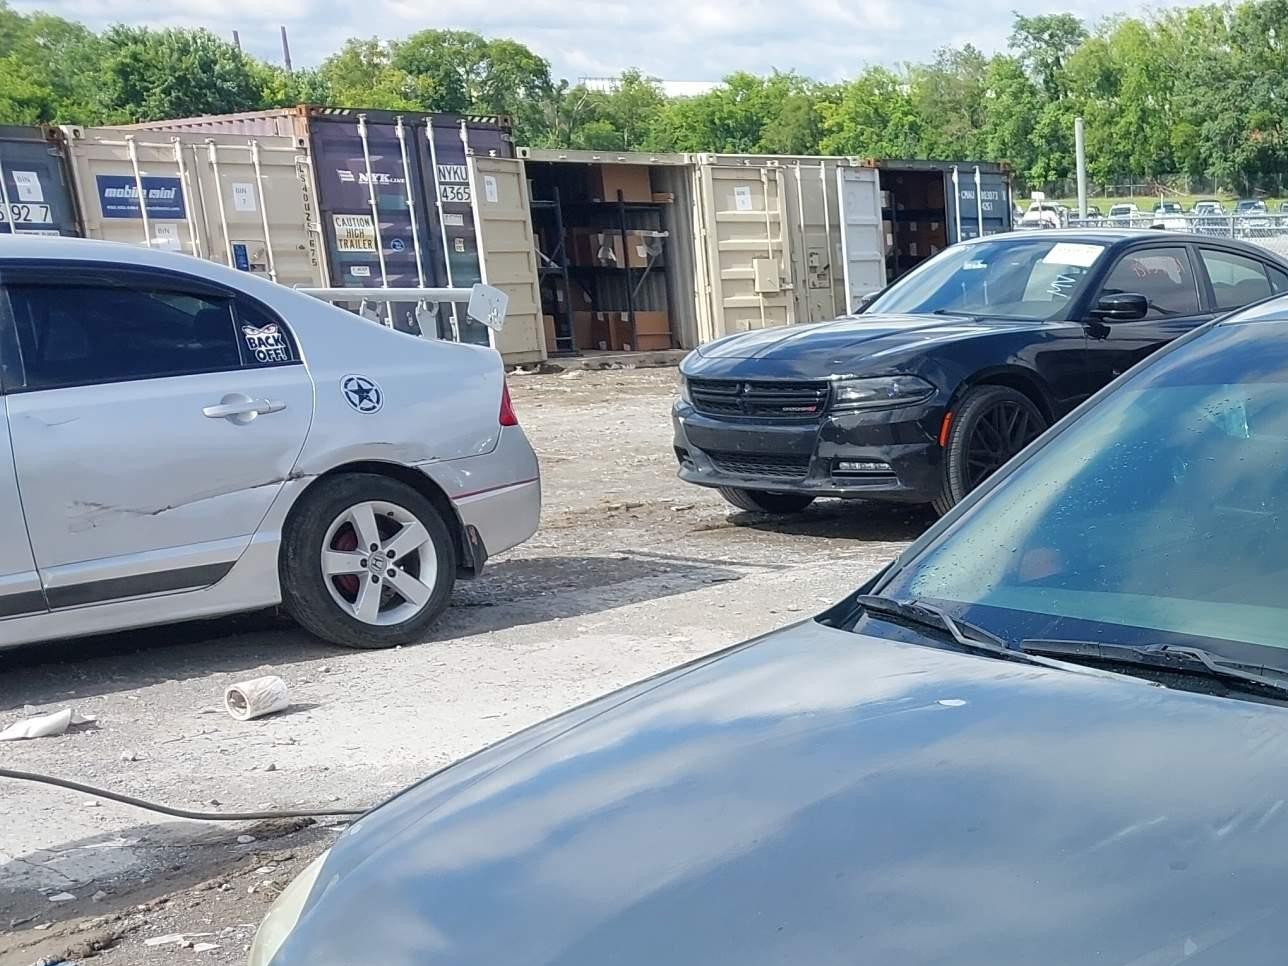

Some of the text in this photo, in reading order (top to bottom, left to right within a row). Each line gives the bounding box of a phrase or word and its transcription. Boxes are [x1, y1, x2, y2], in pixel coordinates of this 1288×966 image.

[359, 172, 391, 182] NYK
[439, 166, 468, 181] NYKU
[148, 187, 177, 199] mini
[442, 186, 471, 201] 4365
[335, 216, 371, 228] CAUTION
[346, 228, 365, 239] HIGH
[339, 238, 374, 250] TRAILER
[247, 333, 285, 350] BACK
[255, 347, 288, 363] OFF!
